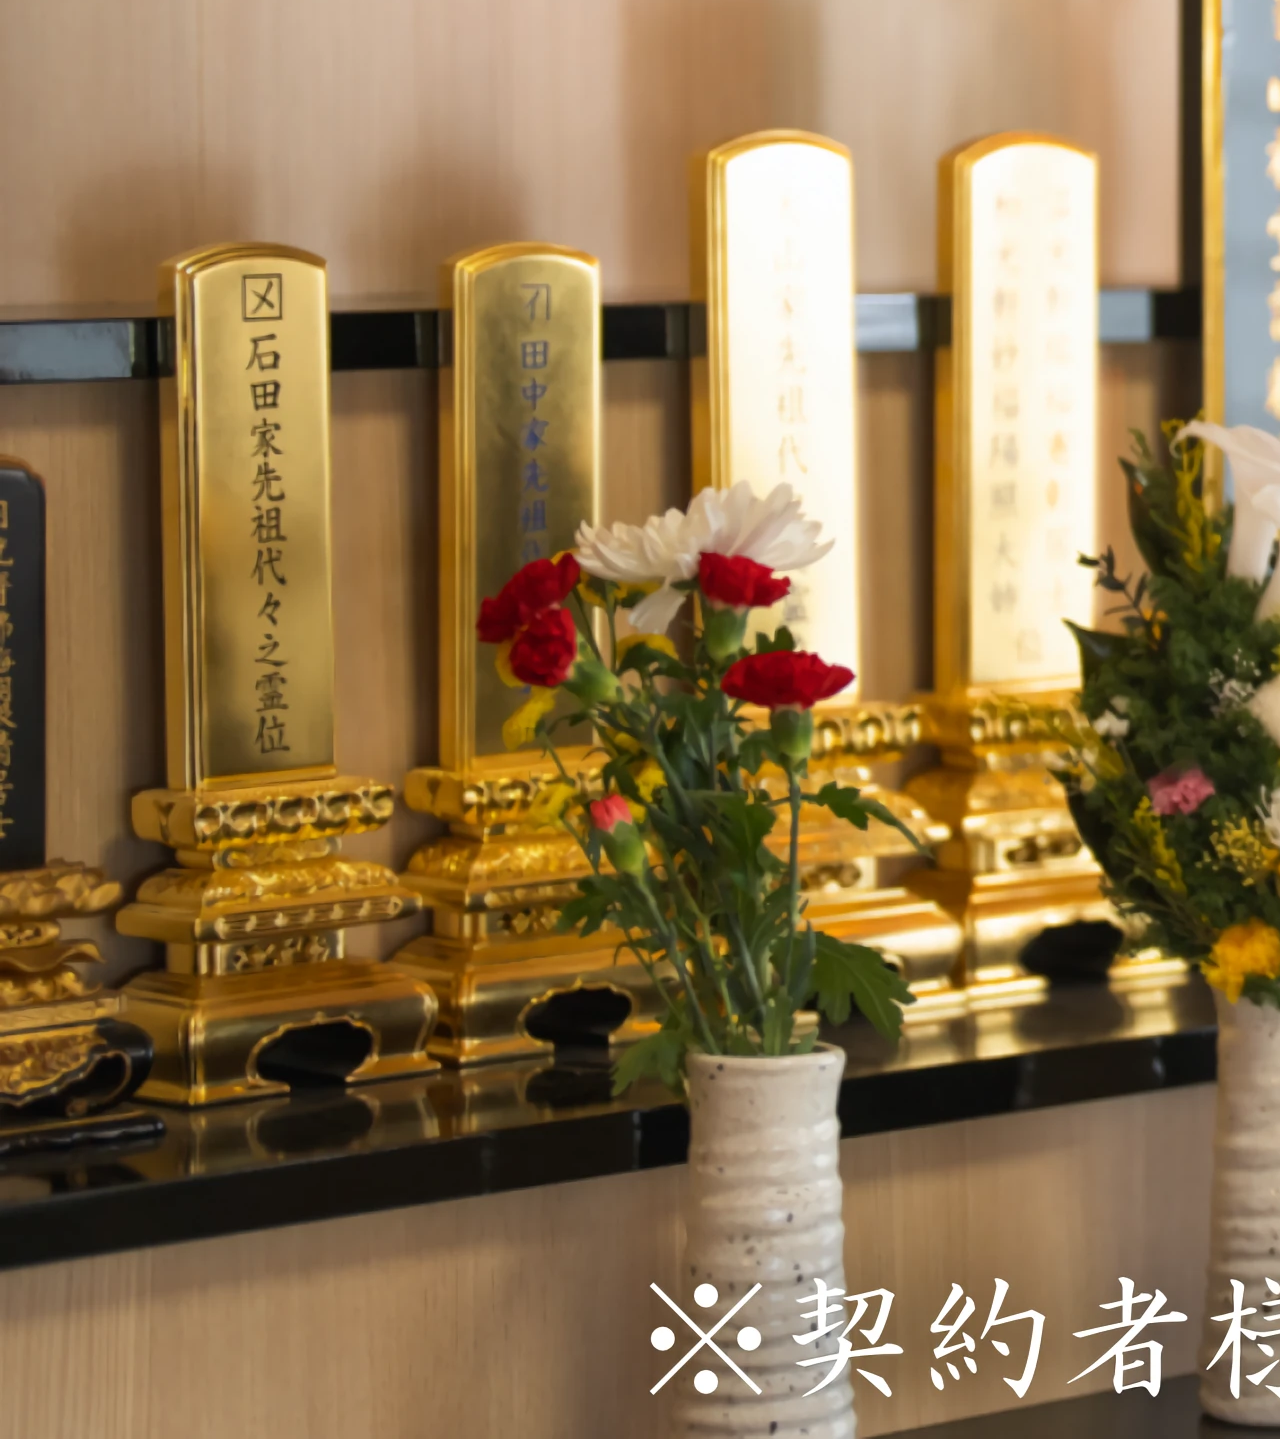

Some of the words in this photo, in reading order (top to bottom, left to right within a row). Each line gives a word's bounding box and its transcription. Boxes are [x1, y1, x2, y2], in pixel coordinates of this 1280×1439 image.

[245, 334, 291, 756] 石田家先祖代々之霊位
